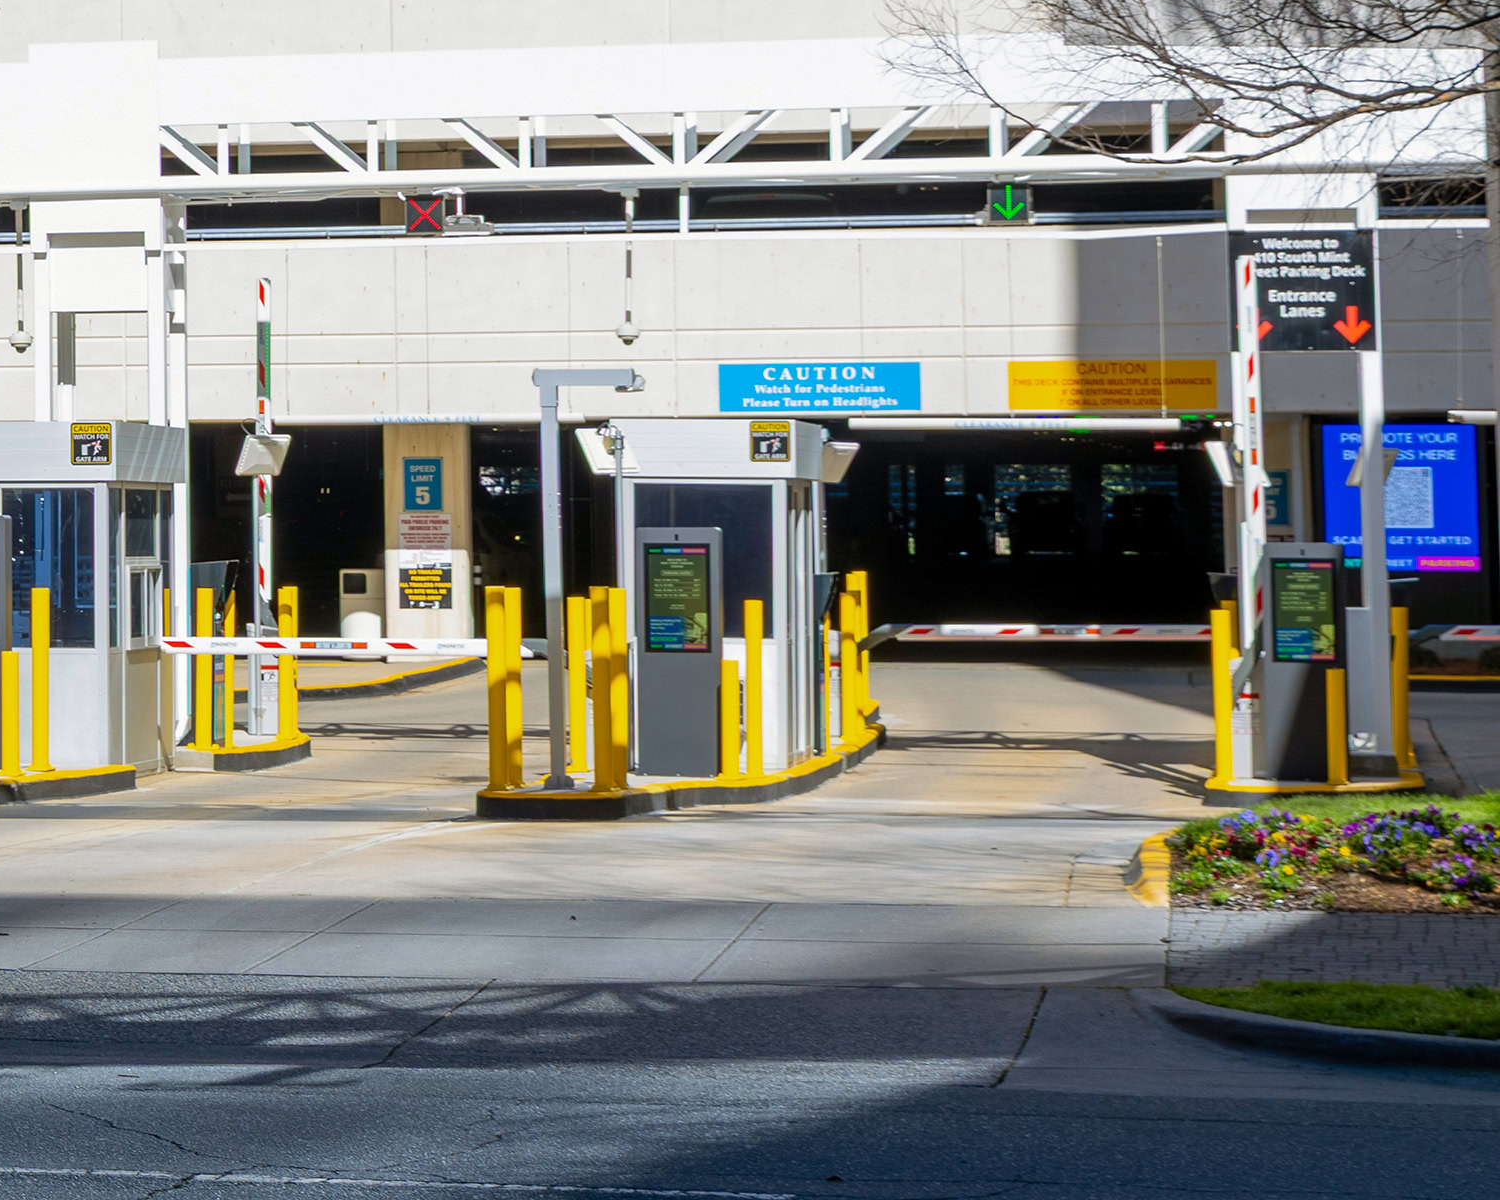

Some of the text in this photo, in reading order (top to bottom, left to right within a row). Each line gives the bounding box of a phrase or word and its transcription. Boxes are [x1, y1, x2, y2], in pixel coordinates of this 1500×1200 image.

[1261, 237, 1339, 250] Welcome to
[1252, 252, 1352, 264] 410 South Mint
[1279, 265, 1331, 280] Parking
[1331, 265, 1367, 278] Deck
[1267, 289, 1337, 302] Entrance
[1279, 305, 1327, 318] Lanes
[762, 366, 876, 381] CAUTION
[1076, 362, 1147, 375] CAUTION
[1012, 377, 1212, 386] THIS DECK CONTAINS MULTIPLE CLEARANCES
[754, 383, 885, 394] Watch for Pedestrians
[1084, 388, 1132, 396] ENTRANCE
[742, 396, 898, 409] Please Turn on Headlights
[1082, 398, 1099, 406] ALL
[1100, 398, 1131, 406] OTHER
[373, 415, 438, 423] CLEARANCE
[455, 415, 481, 423] FEET
[73, 425, 109, 433] CAUTION
[1417, 432, 1459, 443] YOUR
[1418, 449, 1457, 460] HERE
[409, 464, 437, 473] SPEED
[410, 474, 435, 483] LIMIT
[415, 485, 431, 505] 5
[1387, 535, 1412, 545] GET
[1415, 535, 1473, 545] STARTED
[1419, 559, 1476, 567] PARKING
